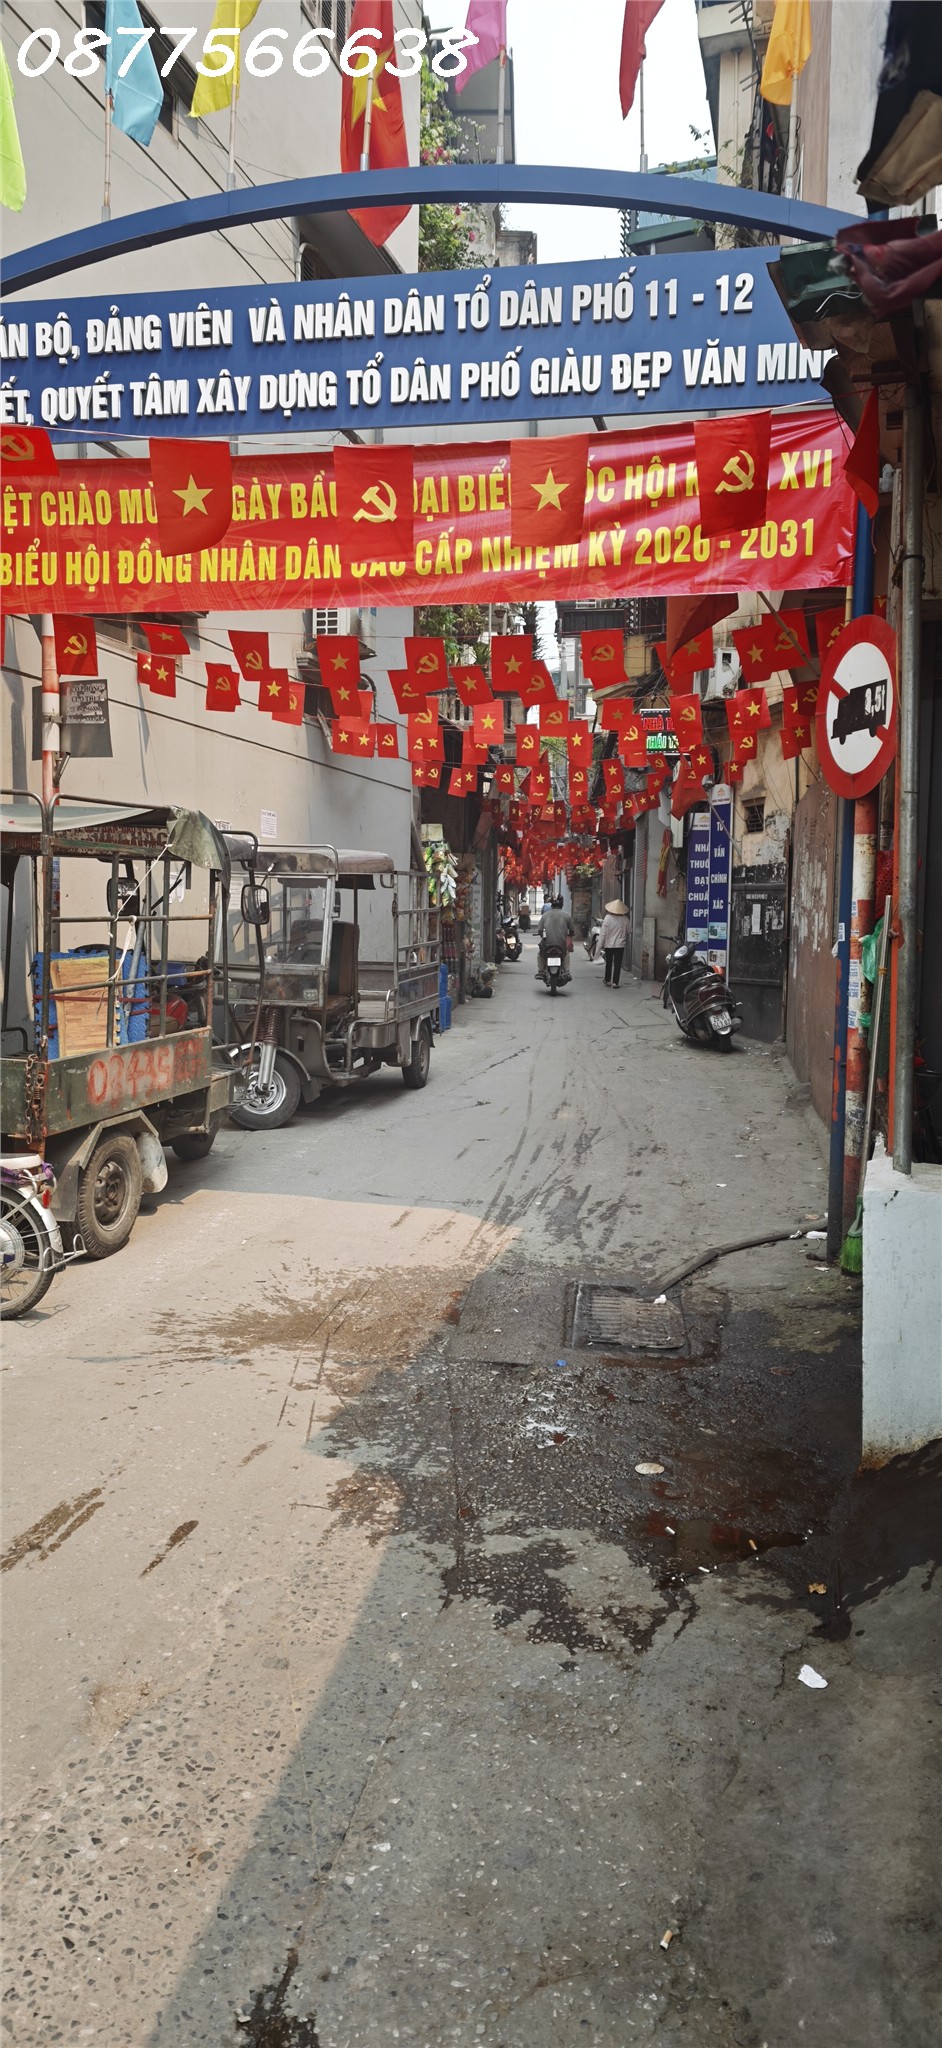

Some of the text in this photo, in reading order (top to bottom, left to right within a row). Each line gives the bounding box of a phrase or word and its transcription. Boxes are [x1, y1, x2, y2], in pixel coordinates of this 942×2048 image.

[35, 312, 80, 365] BỘ,
[86, 304, 163, 354] ĐẢNG
[168, 303, 234, 348] VIÊN
[248, 297, 287, 344] VÀ
[293, 293, 376, 341] NHÂN
[384, 288, 446, 336] DÂN
[454, 274, 491, 331] TỔ
[499, 280, 563, 330] DÂN
[572, 266, 637, 324] PHỐ
[645, 278, 679, 320] 11
[692, 293, 705, 305] -
[715, 272, 755, 315] 12
[41, 371, 125, 424] QUYẾT
[130, 372, 190, 417] TÂM
[197, 369, 252, 415] XÂY
[259, 369, 338, 418] DỰNG
[346, 351, 386, 406] TỔ
[390, 357, 452, 404] DÂN
[461, 345, 523, 399] PHỐ
[530, 347, 602, 396] GIÀU
[611, 350, 673, 399] ĐẸP
[682, 338, 747, 387] VĂN
[40, 482, 111, 526] CHÀO
[232, 477, 283, 521] GÀY
[458, 458, 512, 513] BIỂ
[625, 456, 678, 509] HỘI
[779, 449, 833, 490] XVI
[0, 537, 58, 587] BIỂU
[65, 547, 110, 593] HỘI
[117, 537, 192, 586] ĐỒNG
[200, 540, 278, 583] NHÂN
[285, 537, 342, 580] DÂN
[415, 526, 473, 576] CẤP
[588, 522, 627, 567] KỲ
[635, 525, 710, 565] 2026
[720, 540, 731, 549] -
[740, 518, 814, 560] 2031
[693, 908, 709, 918] GPP
[711, 871, 728, 884] CHÍNH
[712, 897, 724, 910] XÁC
